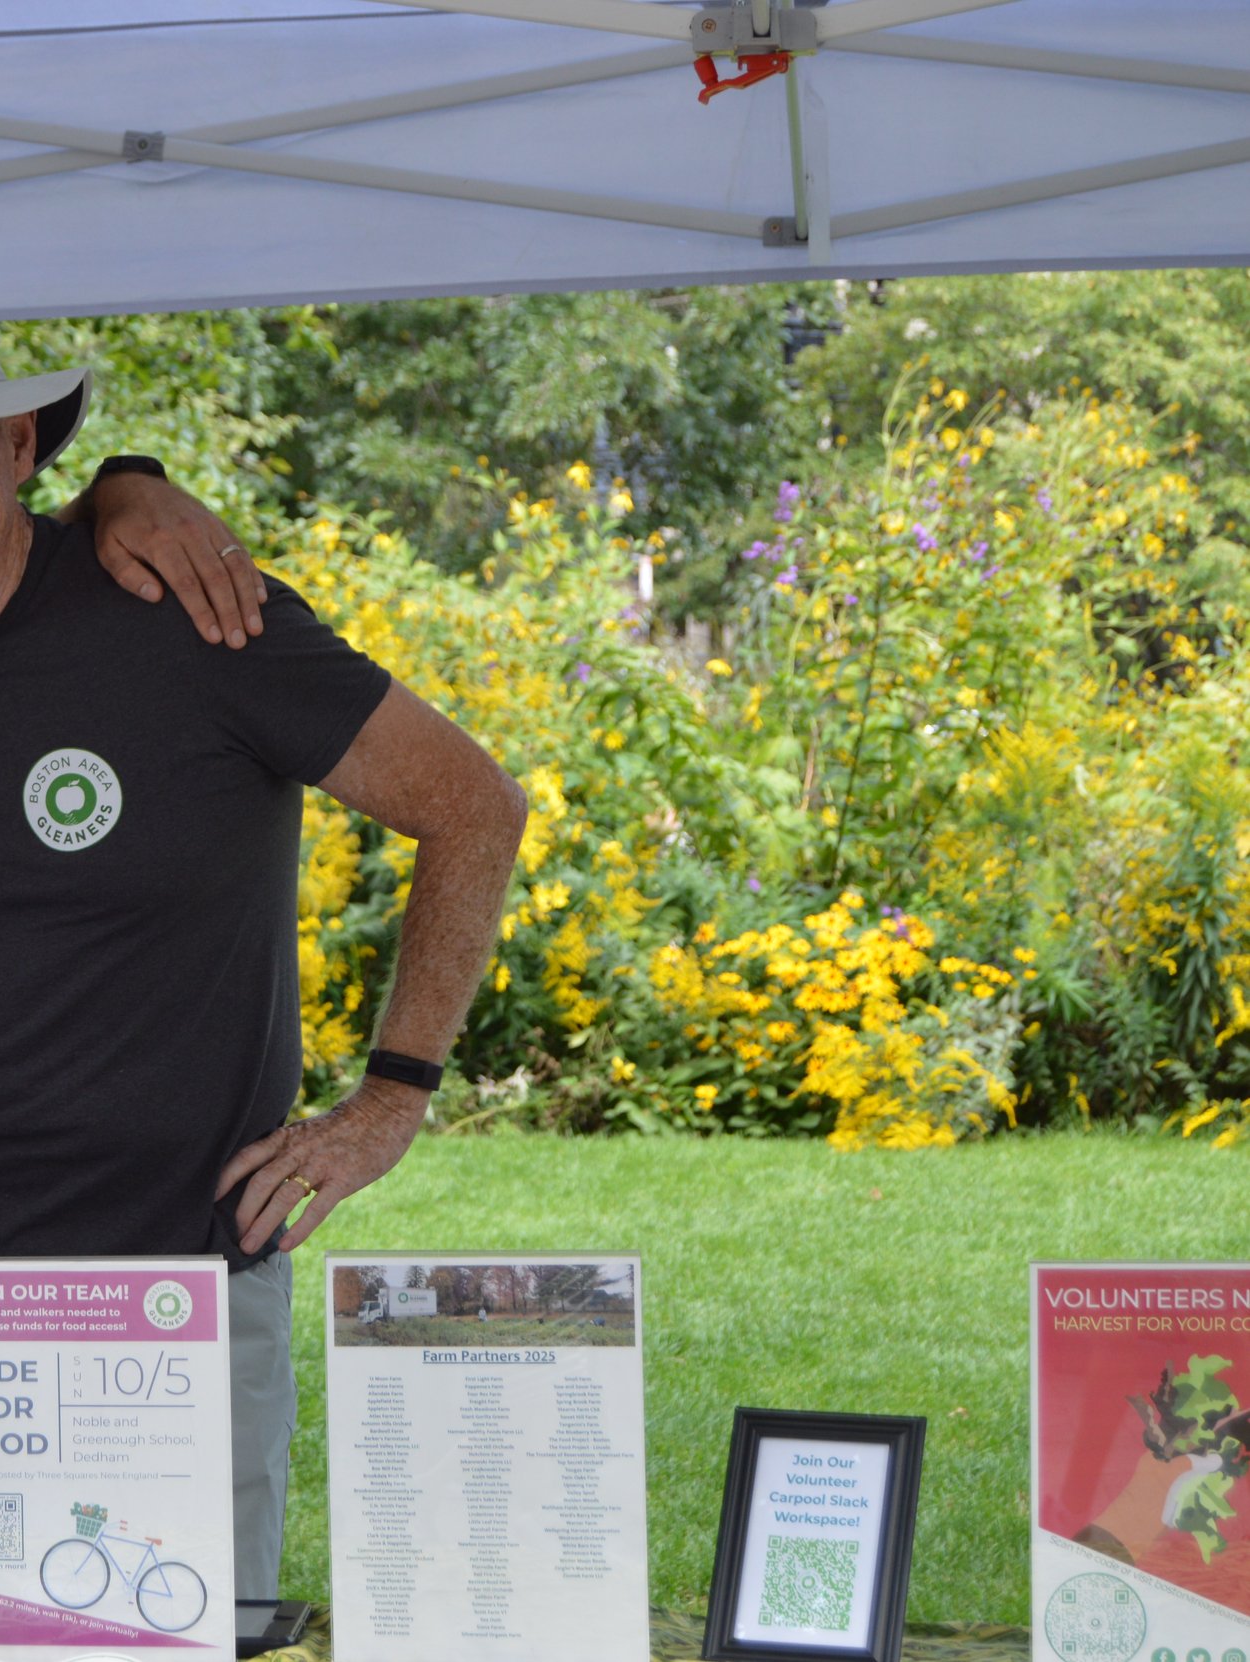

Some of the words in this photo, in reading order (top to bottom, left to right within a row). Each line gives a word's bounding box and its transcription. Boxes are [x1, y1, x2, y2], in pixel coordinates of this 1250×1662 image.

[29, 756, 71, 803] BOSTON
[78, 758, 113, 792] AREA
[37, 804, 113, 845] GLEANERS
[11, 1285, 57, 1300] OUR
[63, 1285, 129, 1300] TEAM!
[148, 1284, 170, 1304] BOSTON
[1045, 1288, 1224, 1309] VOLUNTEERS
[1, 1307, 21, 1317] and
[23, 1307, 64, 1317] walkers
[67, 1307, 107, 1317] needed
[109, 1308, 120, 1317] to
[149, 1310, 187, 1327] GLEANERS
[12, 1322, 42, 1331] funds
[44, 1322, 60, 1331] for
[62, 1322, 87, 1331] food
[89, 1322, 127, 1331] access!
[1054, 1316, 1132, 1331] HARVEST
[1137, 1316, 1172, 1331] FOR
[1176, 1317, 1225, 1331] YOUR
[423, 1350, 458, 1362] Farm
[461, 1350, 520, 1362] Partners
[524, 1350, 556, 1362] 2025
[93, 1350, 191, 1400] 10/5
[72, 1416, 110, 1427] Noble
[113, 1416, 139, 1427] and
[72, 1434, 145, 1446] Greenough
[149, 1434, 196, 1446] School,
[73, 1452, 129, 1463] Dedham
[792, 1454, 823, 1467] Join
[827, 1456, 855, 1468] Our
[25, 1471, 35, 1481] by
[36, 1471, 62, 1479] Three
[63, 1471, 98, 1481] Squares
[100, 1472, 120, 1480] New
[122, 1472, 159, 1481] England
[786, 1472, 857, 1488] Volunteer
[769, 1491, 826, 1506] Carpool
[830, 1494, 868, 1508] Slack
[774, 1511, 860, 1527] Workspace!
[1050, 1535, 1073, 1551] Scan
[1075, 1545, 1092, 1559] the
[1094, 1554, 1120, 1571] code
[1121, 1565, 1131, 1575] or
[1133, 1571, 1153, 1585] visit
[0, 1597, 14, 1608] 62.2
[42, 1607, 60, 1618] walk
[88, 1619, 104, 1631] join
[105, 1623, 139, 1638] virtually!
